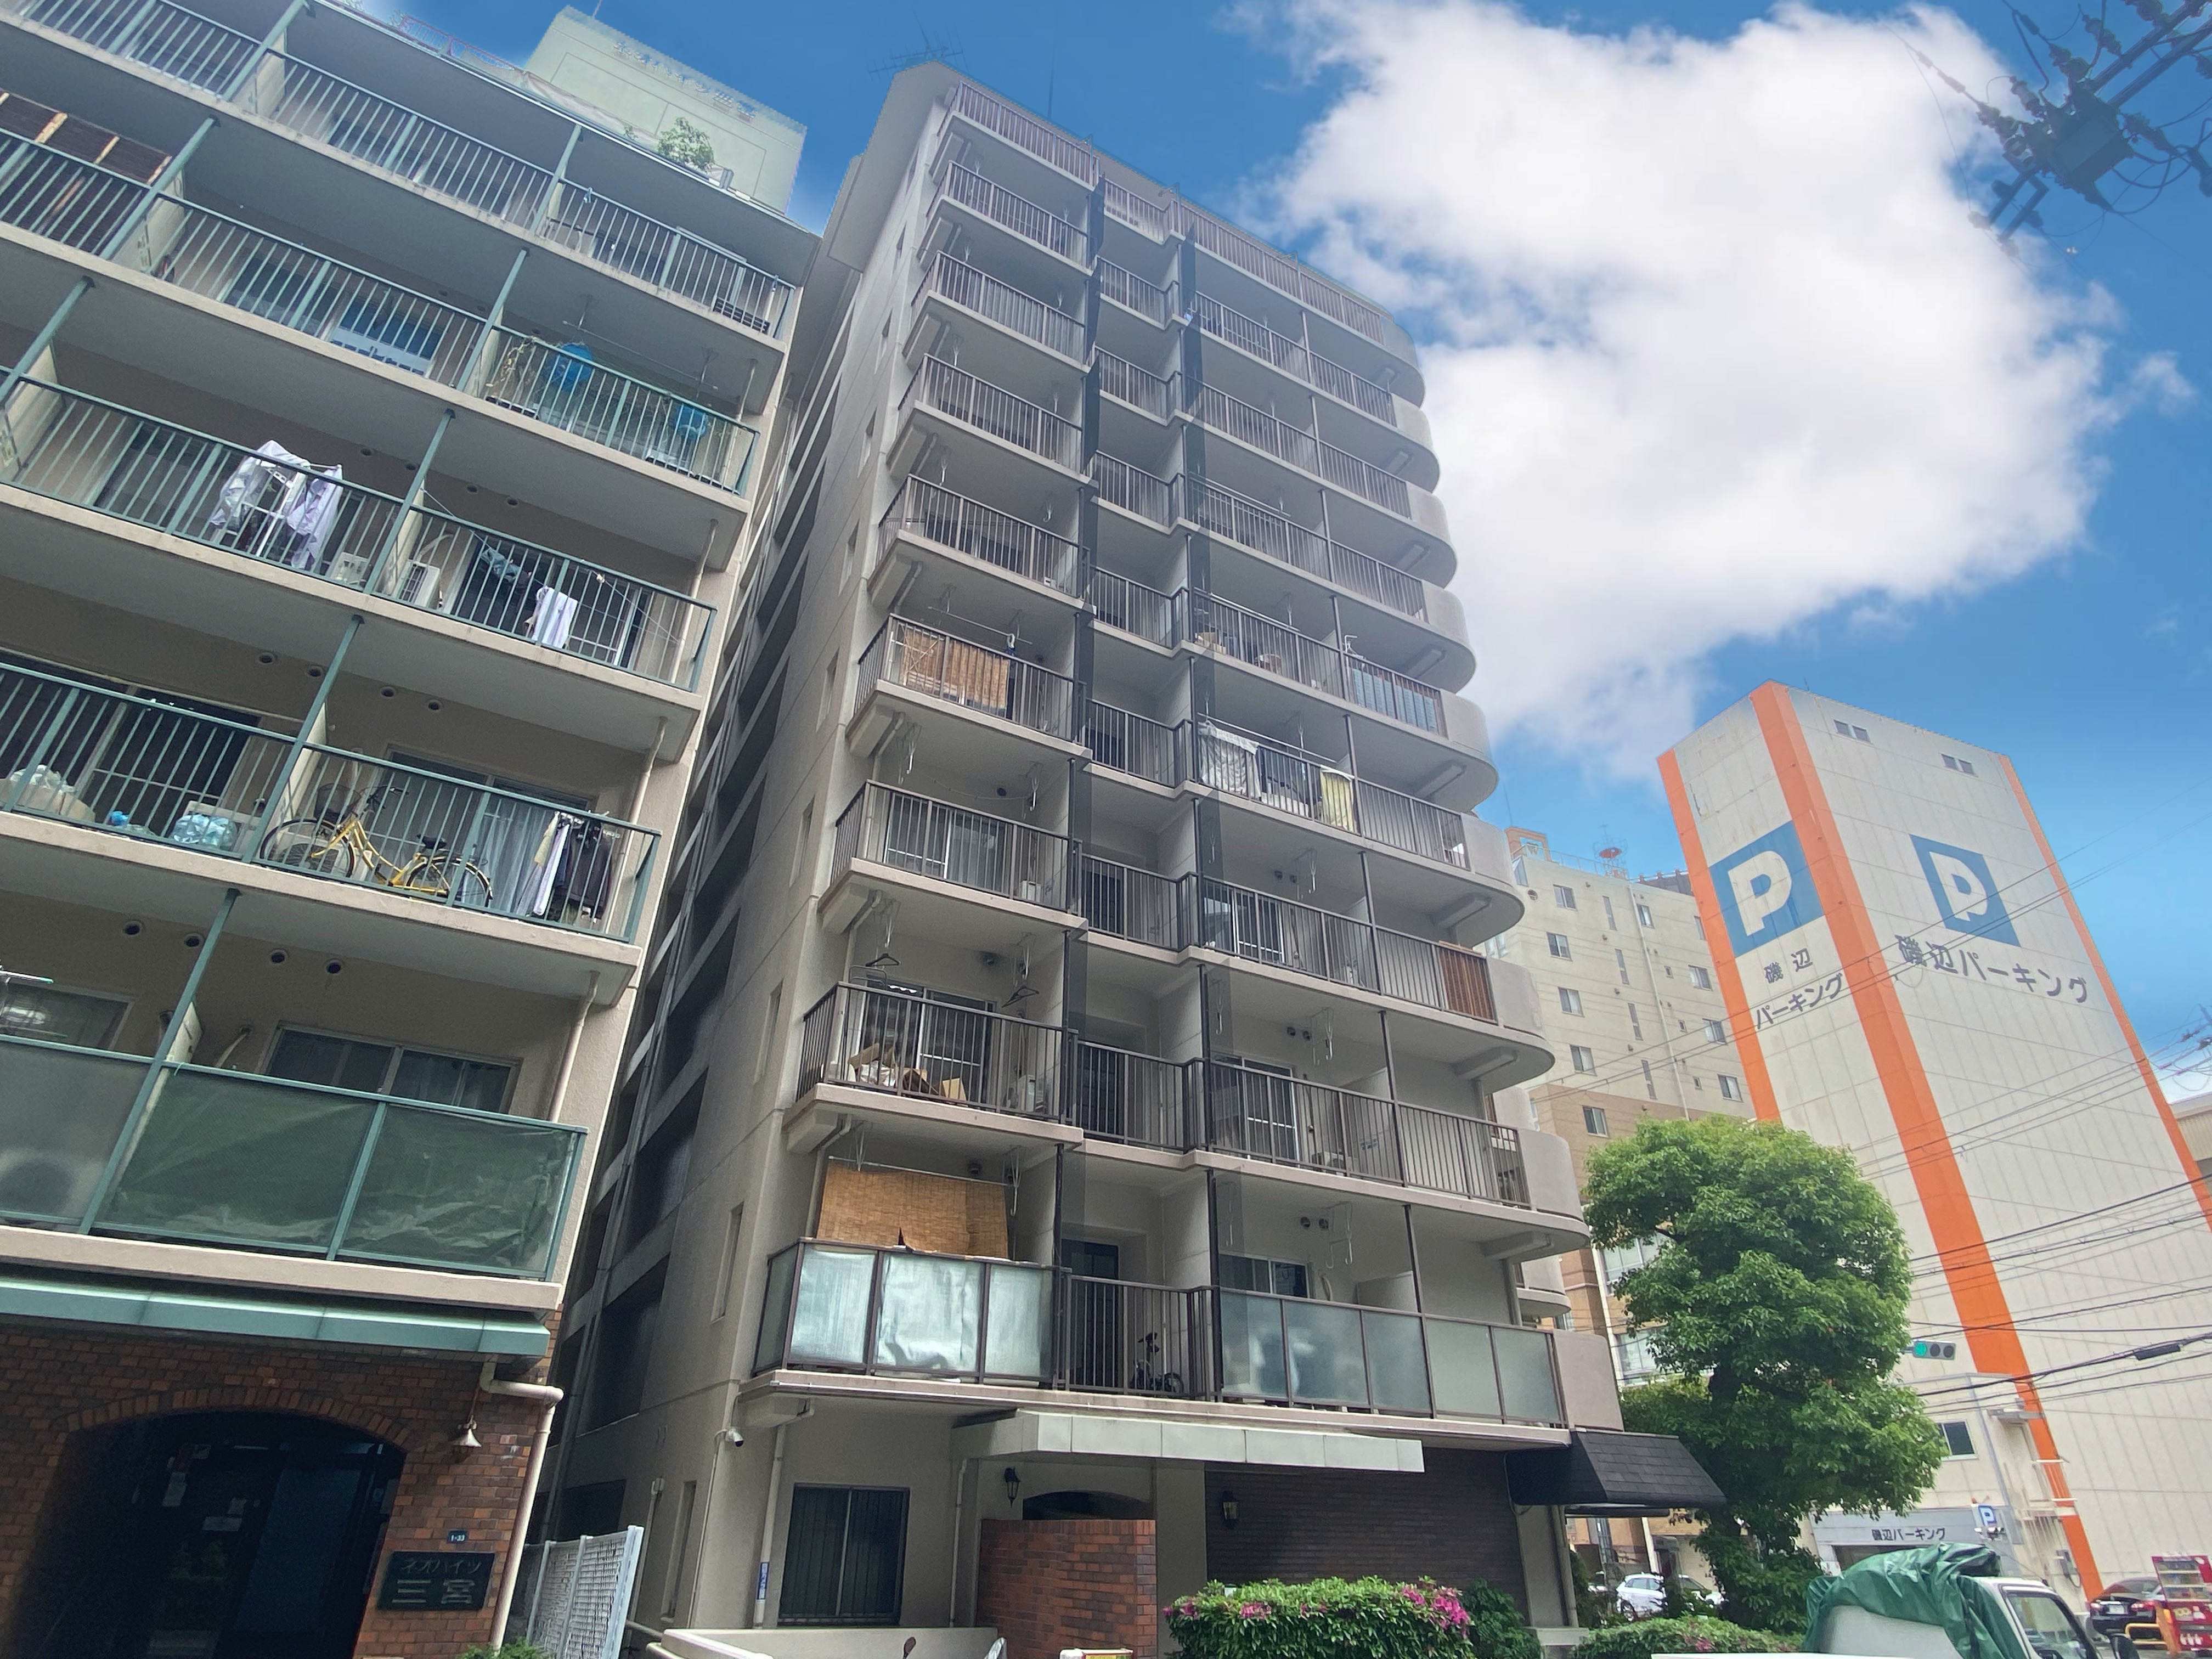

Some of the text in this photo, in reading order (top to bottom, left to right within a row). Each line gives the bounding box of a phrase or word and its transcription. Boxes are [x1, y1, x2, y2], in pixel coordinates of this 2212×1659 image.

[1728, 850, 1792, 936] P
[1929, 851, 1988, 922] P
[1894, 934, 2088, 1004] 磯辺パーキング
[1756, 972, 1843, 1030] パーキング
[1980, 1506, 1996, 1527] P
[391, 1578, 476, 1605] 三宮
[401, 1557, 482, 1575] ネオハイツ
